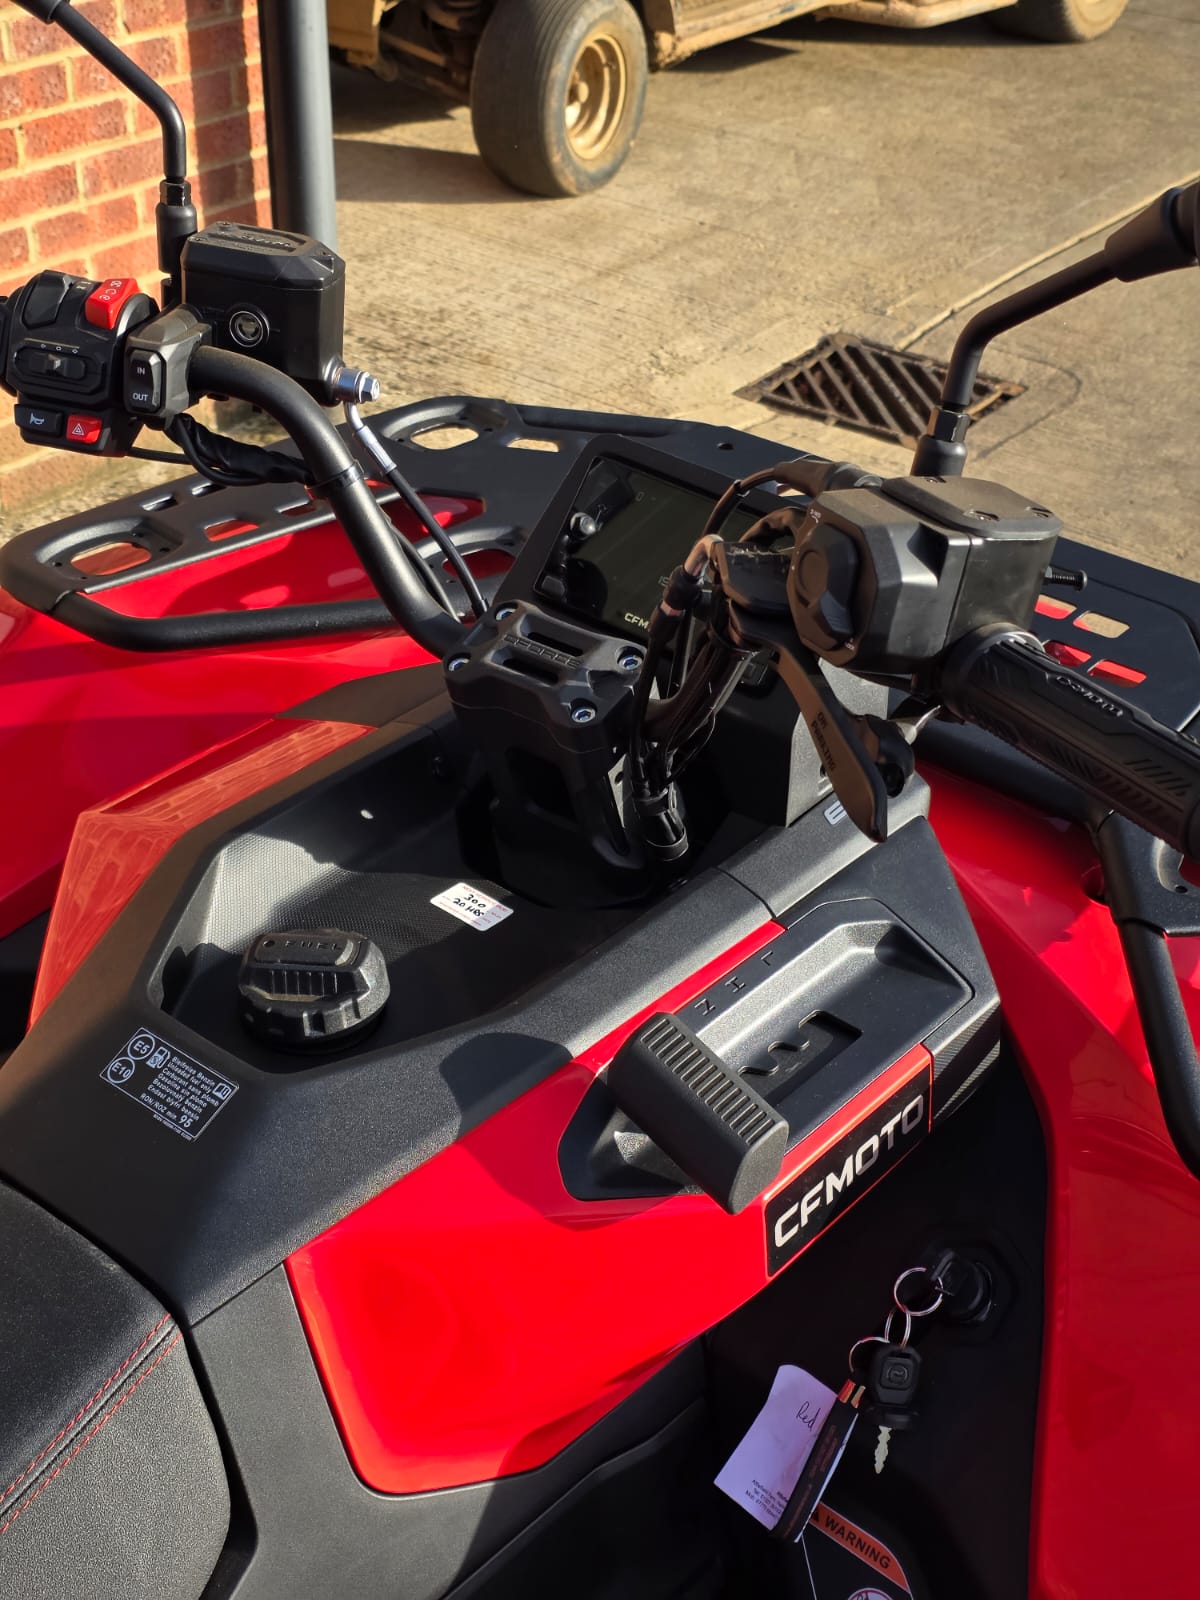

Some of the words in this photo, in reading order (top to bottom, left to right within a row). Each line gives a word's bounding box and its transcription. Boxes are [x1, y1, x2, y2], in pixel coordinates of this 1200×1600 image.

[137, 367, 146, 375] IN
[132, 392, 149, 401] OUT
[624, 612, 650, 629] CFM
[452, 898, 466, 907] 20
[464, 893, 487, 908] 300
[724, 976, 746, 993] H
[694, 998, 716, 1016] N
[133, 1040, 150, 1054] E5
[111, 1062, 131, 1078] E10
[162, 1068, 188, 1087] Carburant
[140, 1092, 167, 1115] RON/ROZ
[178, 1115, 193, 1128] 95
[774, 1094, 924, 1247] CFMOTO
[825, 1514, 891, 1569] WARNING
